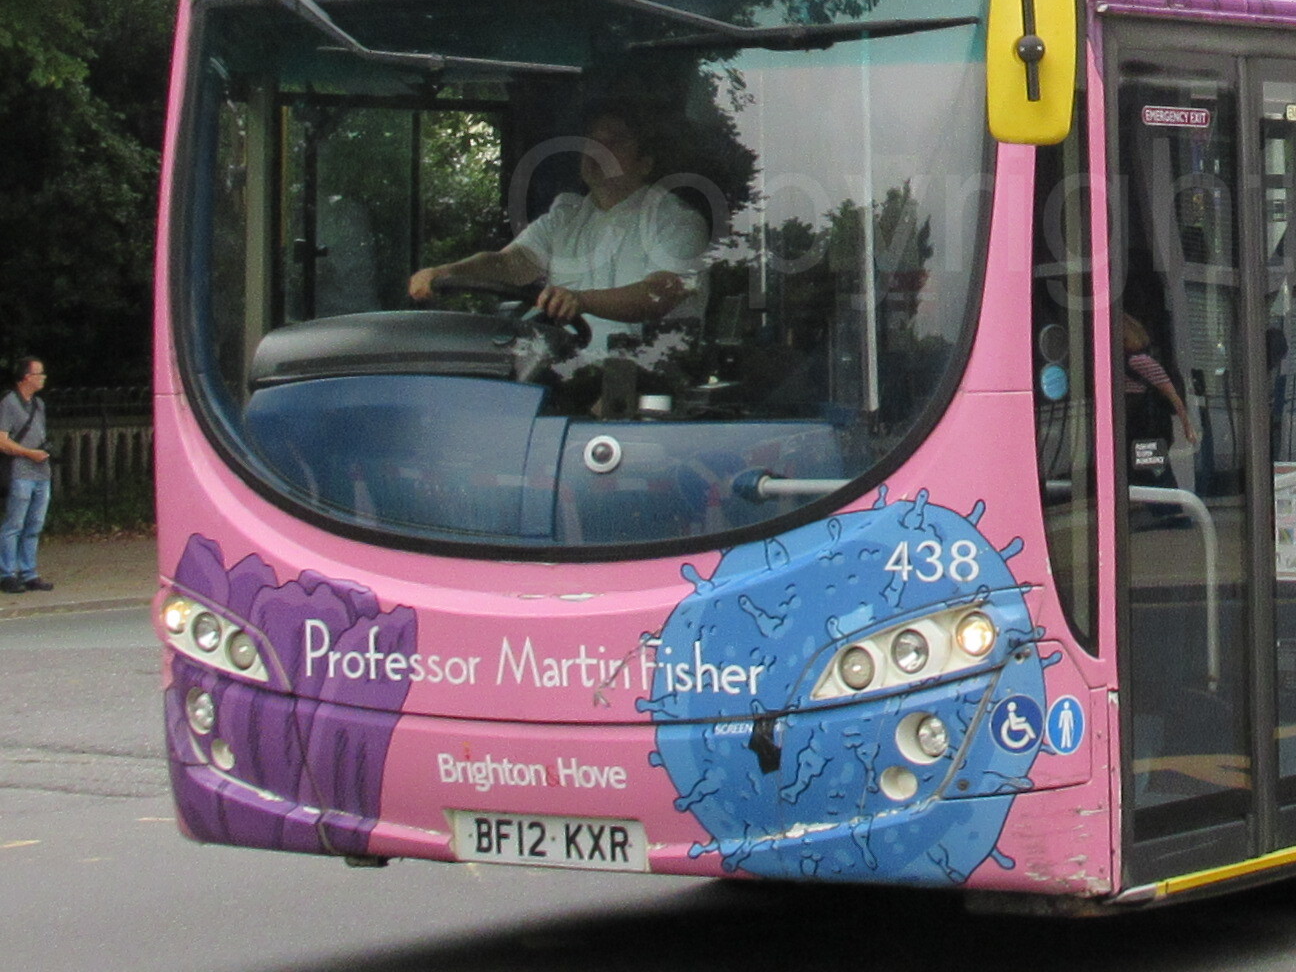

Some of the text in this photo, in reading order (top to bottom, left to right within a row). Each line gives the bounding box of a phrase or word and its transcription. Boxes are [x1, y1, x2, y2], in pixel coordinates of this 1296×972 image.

[1145, 109, 1207, 124] EMERGENCY EXIT
[883, 539, 979, 583] 438
[305, 618, 765, 695] Professor Martin Fisher
[437, 753, 547, 792] Brighton
[557, 757, 628, 789] Hove
[474, 817, 630, 863] BF12 KXR
